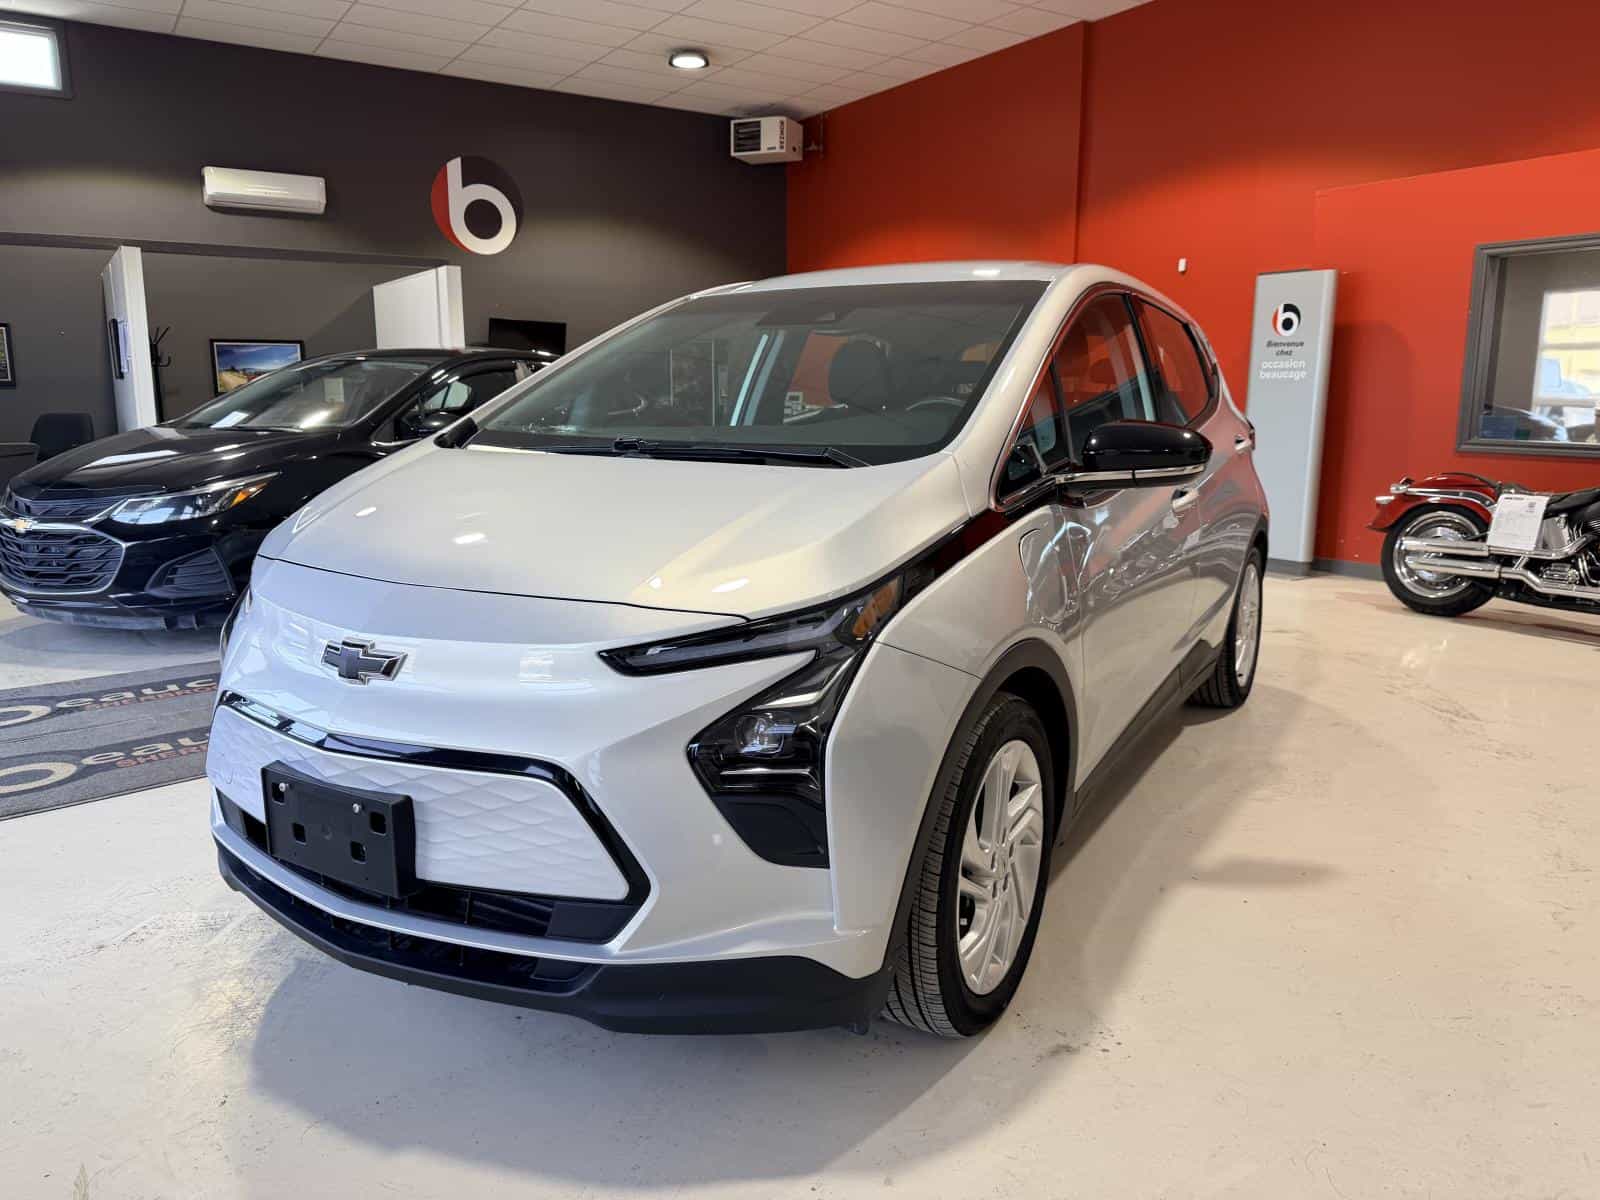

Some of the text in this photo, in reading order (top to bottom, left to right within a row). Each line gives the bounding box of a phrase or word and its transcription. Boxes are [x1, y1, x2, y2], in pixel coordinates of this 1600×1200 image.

[446, 156, 517, 255] b
[1276, 302, 1299, 337] b
[1266, 340, 1304, 348] Bienvenue
[1262, 359, 1305, 369] occasion
[1259, 370, 1306, 380] beaucage
